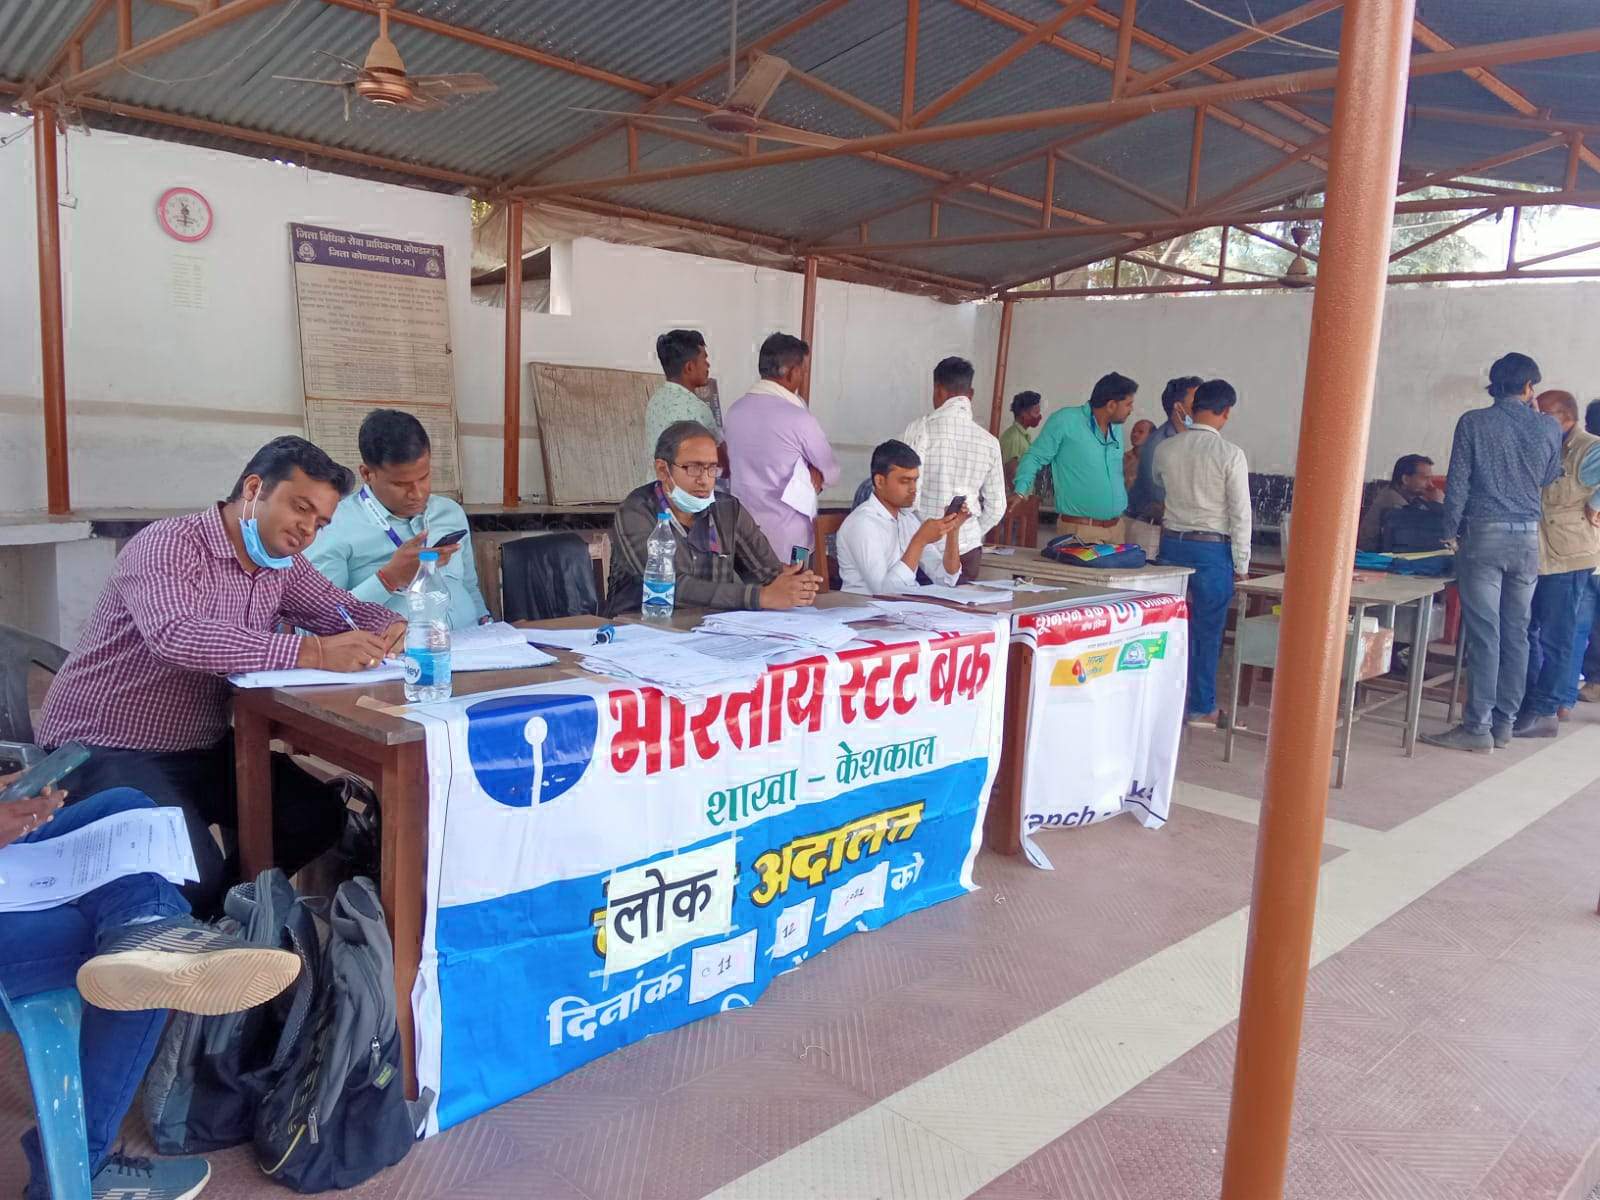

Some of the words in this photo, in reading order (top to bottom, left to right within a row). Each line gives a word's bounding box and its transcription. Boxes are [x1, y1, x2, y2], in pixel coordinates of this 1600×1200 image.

[296, 228, 318, 241] जिला
[328, 246, 350, 258] जिला
[835, 639, 921, 724] स्टेट
[707, 767, 798, 827] शाखा
[836, 735, 937, 785] केशकाल
[610, 868, 718, 944] लोक
[750, 800, 926, 907] अदालत
[547, 964, 686, 1047] दिनांक
[890, 852, 925, 890] को
